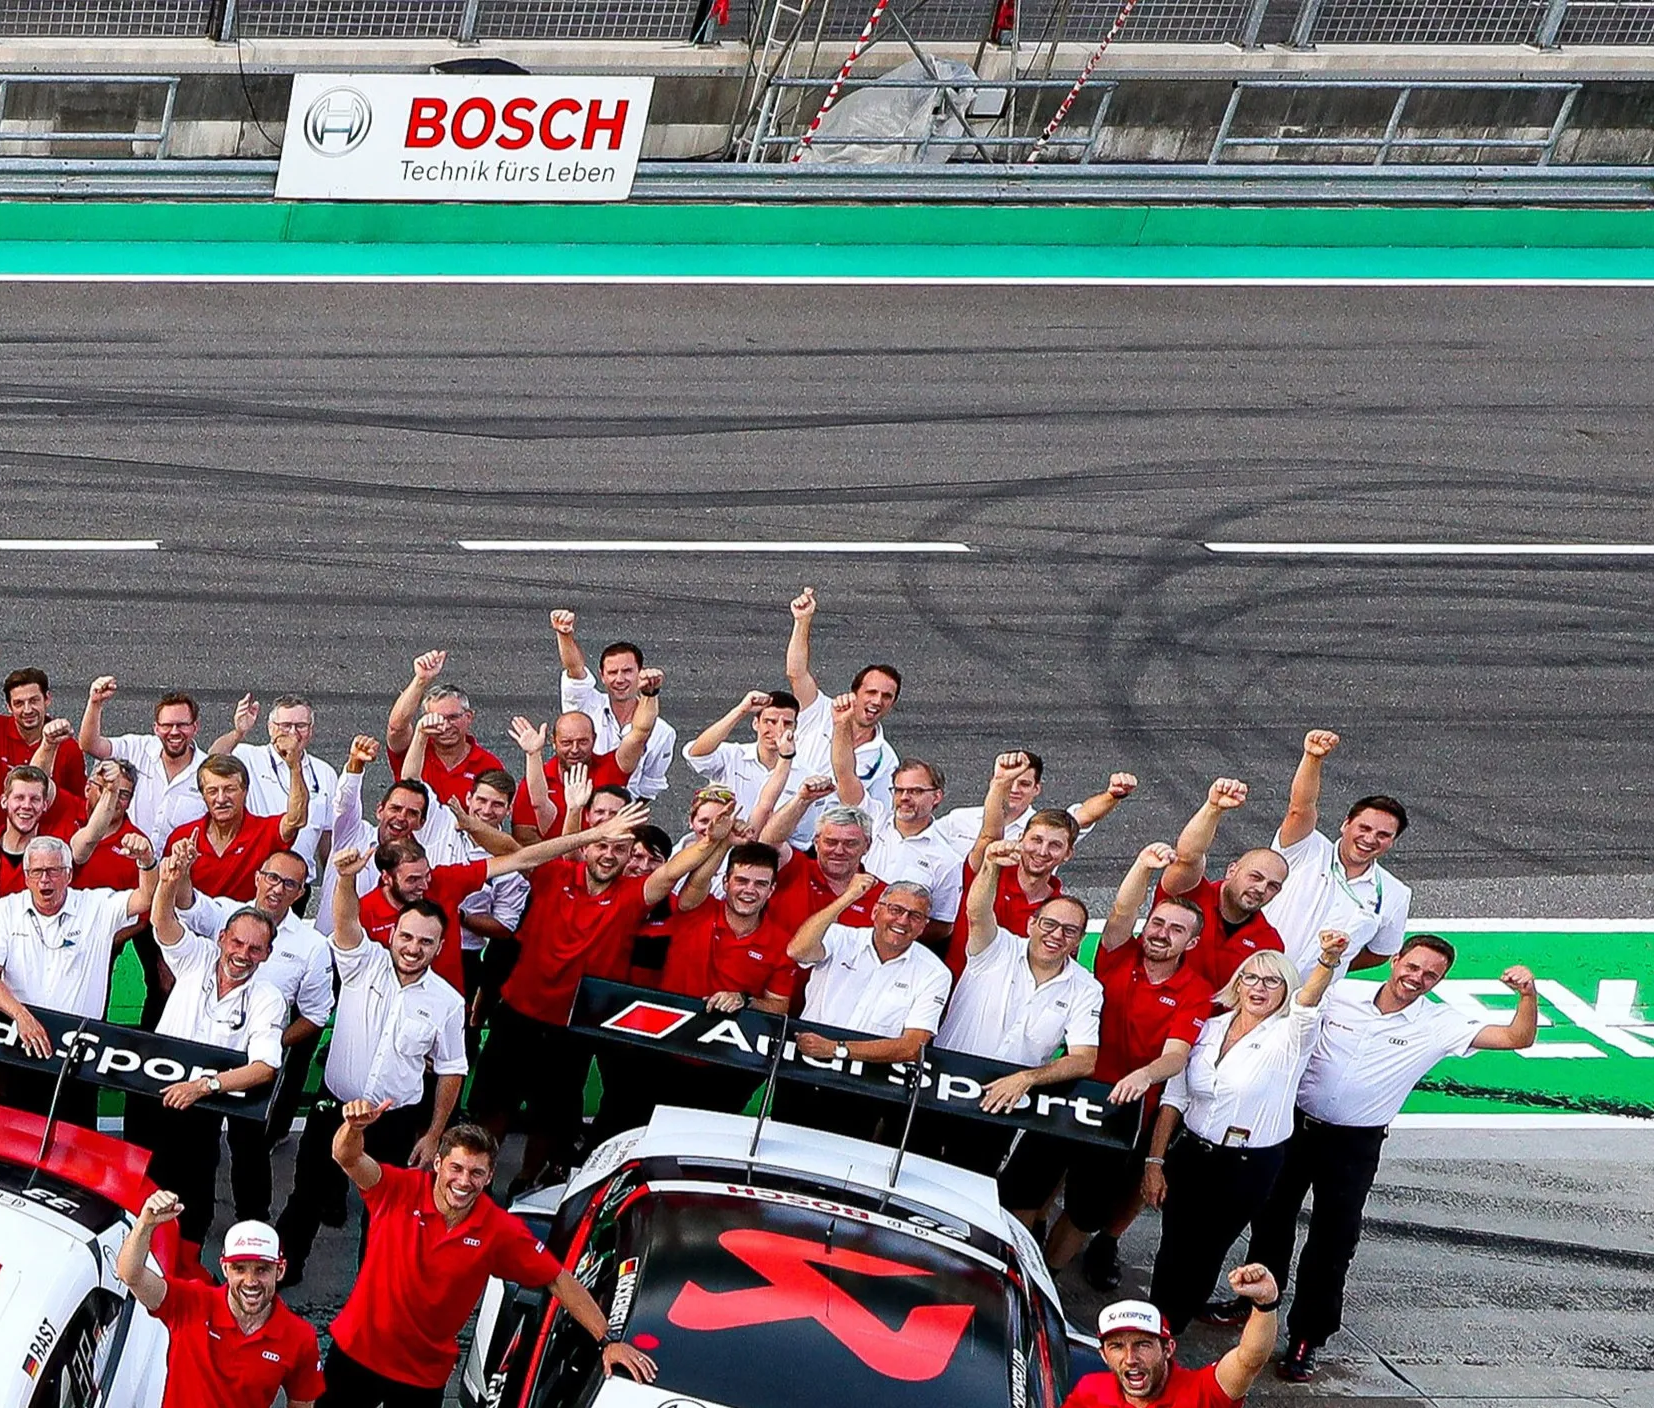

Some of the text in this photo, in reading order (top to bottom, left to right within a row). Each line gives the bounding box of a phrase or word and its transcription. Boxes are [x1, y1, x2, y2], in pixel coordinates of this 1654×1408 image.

[404, 97, 629, 150] BOSCH
[401, 160, 615, 183] Technik fürs Leben
[56, 1029, 247, 1098] Spor
[889, 1058, 1103, 1128] Sprt
[727, 1186, 869, 1220] BOSCH
[30, 1317, 59, 1363] RAST
